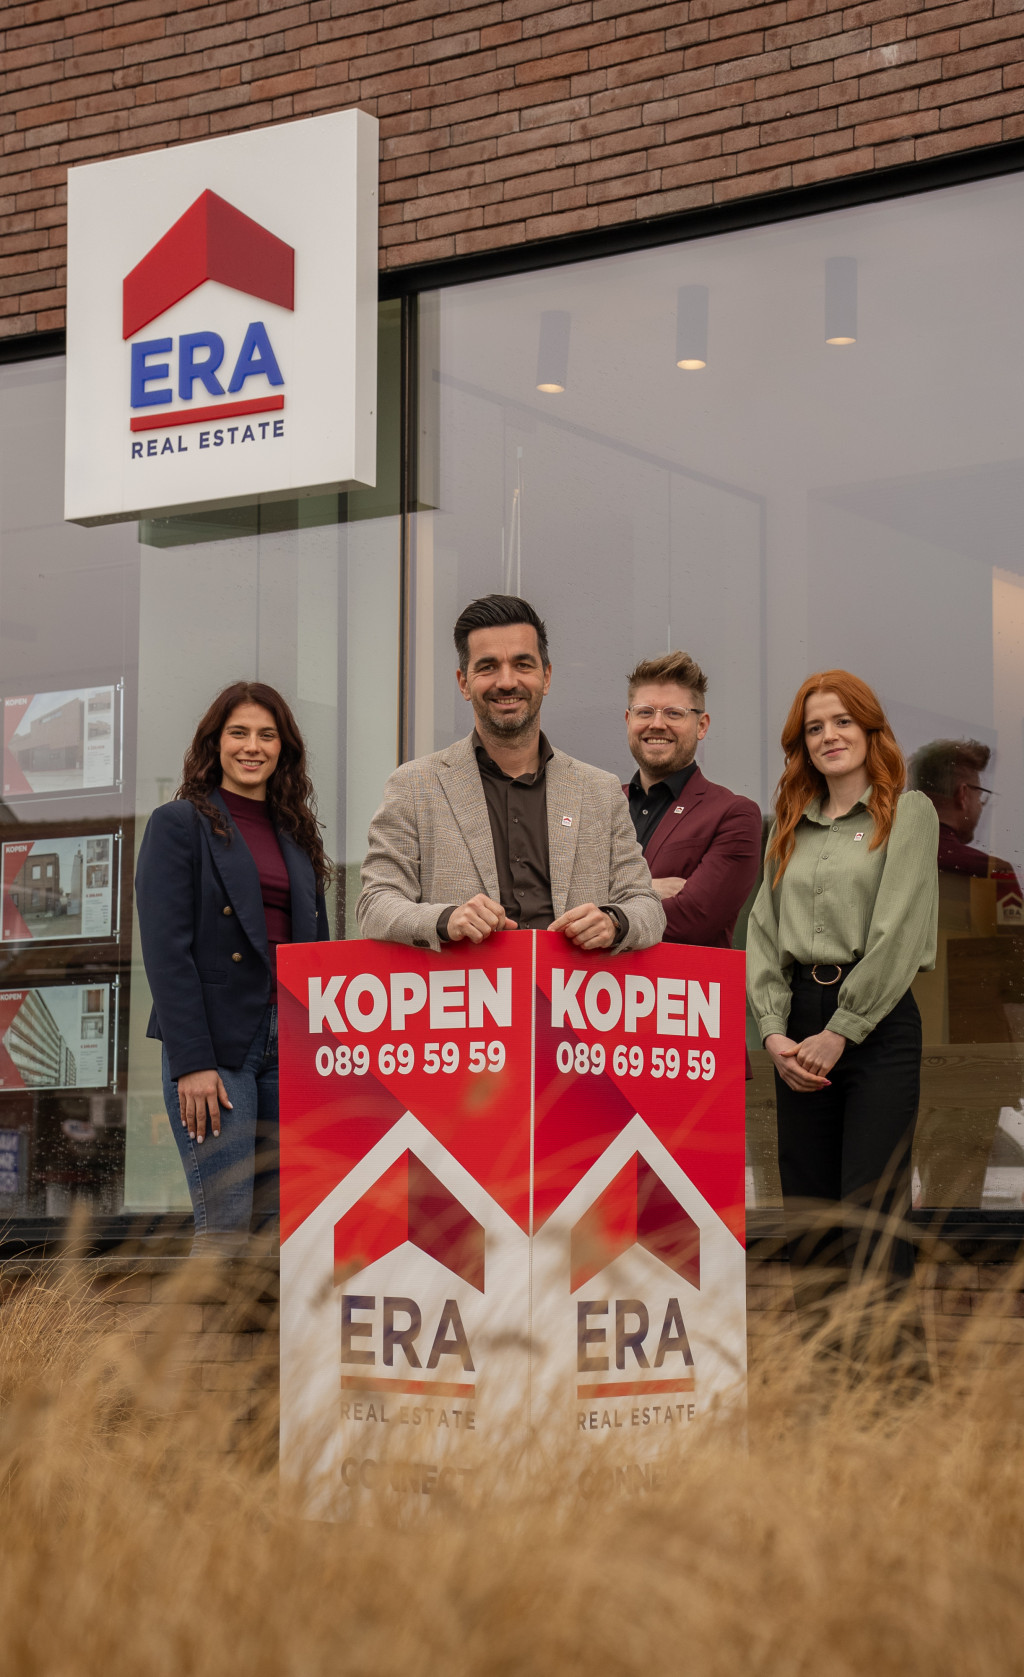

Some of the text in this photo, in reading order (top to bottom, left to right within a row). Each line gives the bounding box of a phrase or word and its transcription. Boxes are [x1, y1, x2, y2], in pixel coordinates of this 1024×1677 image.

[130, 321, 285, 408] ERA
[131, 419, 285, 459] REAL ESTATE
[4, 698, 28, 707] KOPEN
[5, 845, 28, 854] KOPEN
[0, 992, 22, 1001] KOPEN
[307, 967, 513, 1034] KOPEN
[551, 967, 721, 1039] KOPEN
[314, 1040, 506, 1077] 089 69 59 59
[556, 1040, 716, 1081] 089 69 59 59
[340, 1294, 476, 1372] ERA
[576, 1297, 695, 1373] ERA
[340, 1401, 475, 1430] REAL ESTATE
[577, 1403, 695, 1430] REAL ESTATE
[578, 1462, 670, 1501] CONNE
